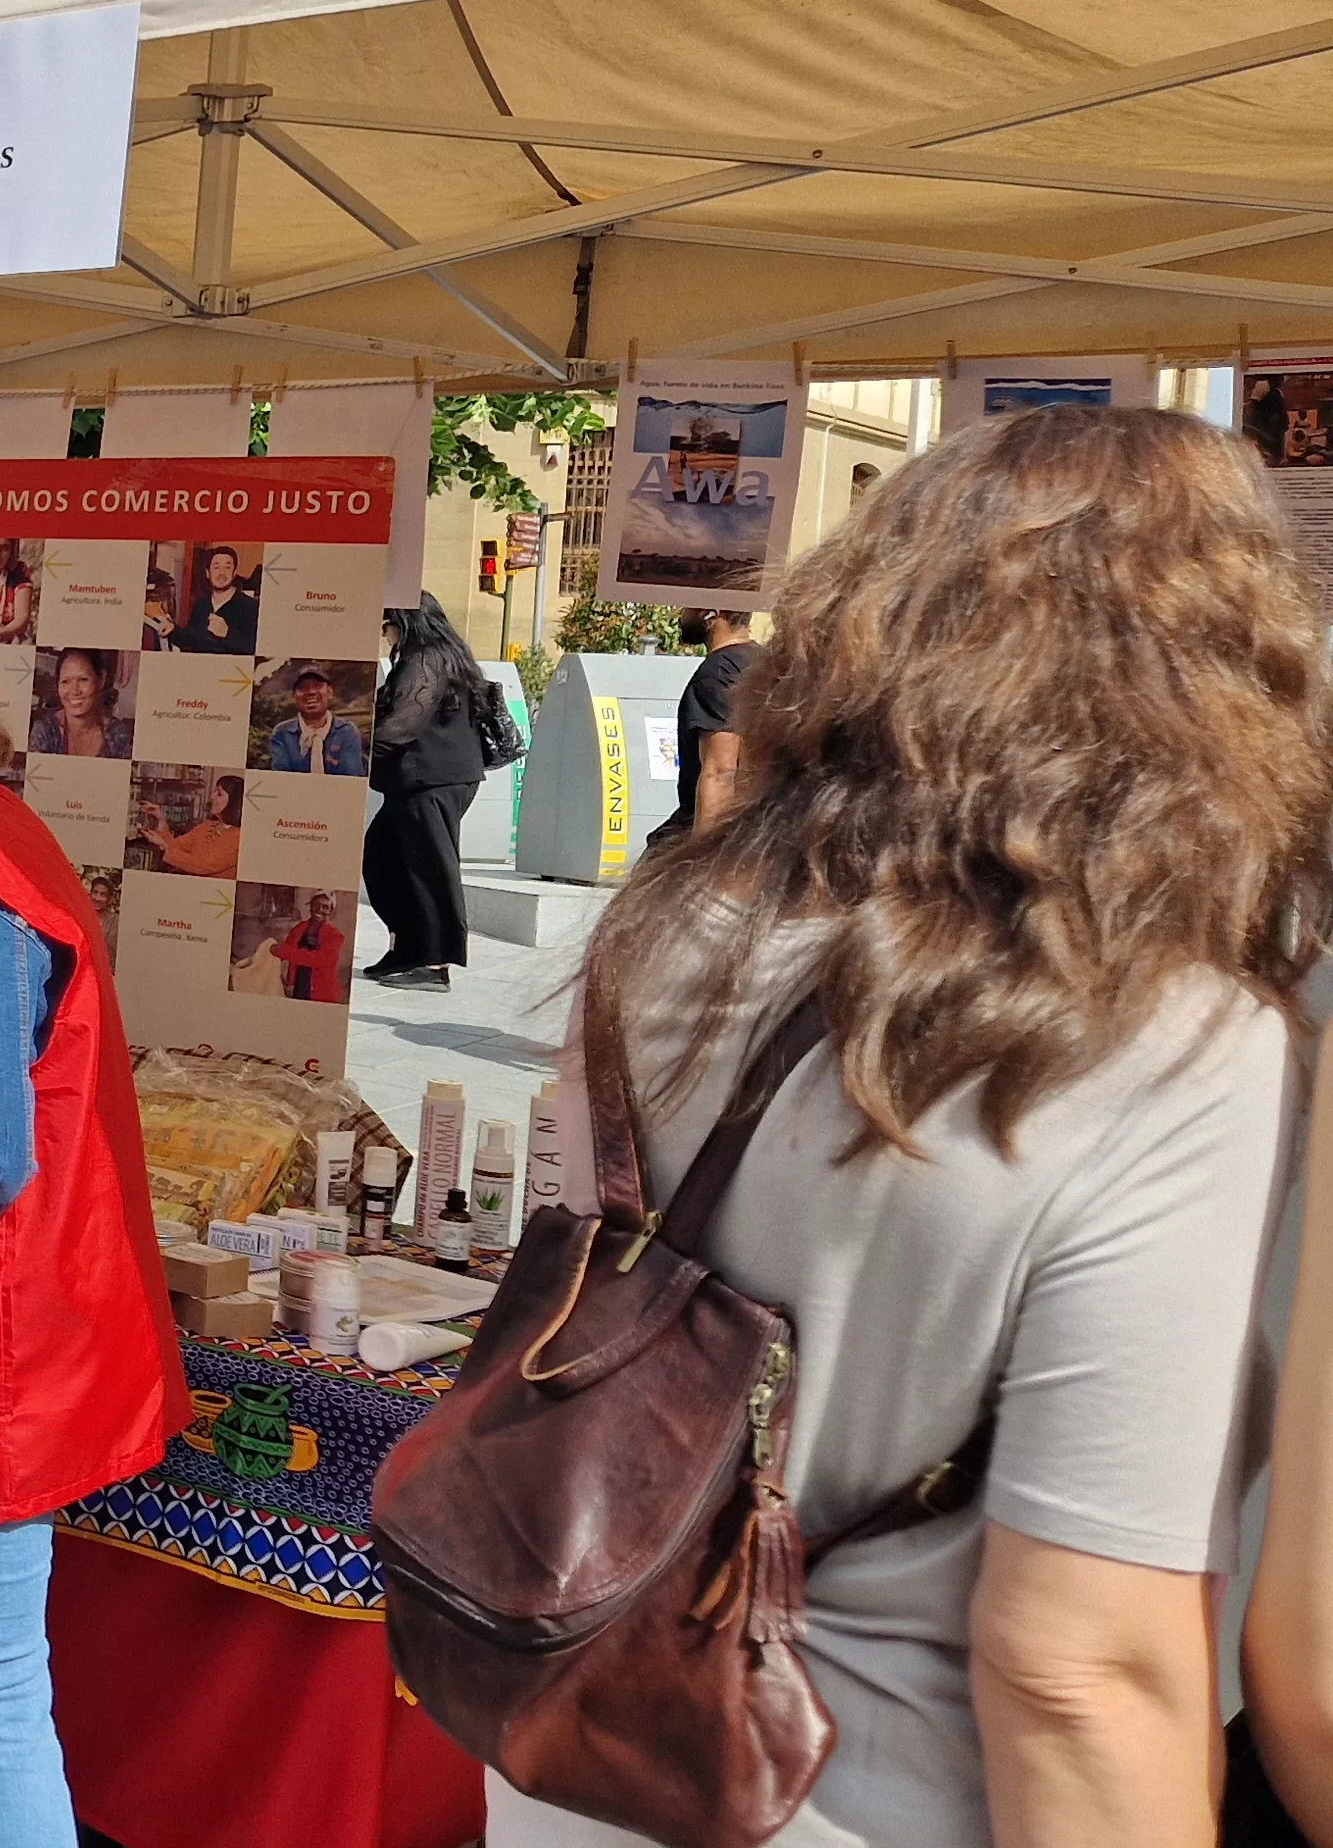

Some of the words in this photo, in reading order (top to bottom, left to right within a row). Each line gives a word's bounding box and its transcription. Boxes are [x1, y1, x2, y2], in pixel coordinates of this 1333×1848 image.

[663, 380, 688, 389] fuente
[689, 381, 700, 389] de
[701, 381, 718, 389] vida
[733, 381, 764, 390] Burkina
[630, 456, 770, 507] Awa
[82, 489, 249, 514] COMERCIO
[262, 489, 371, 515] JUSTO
[68, 584, 117, 594] Mamtuben
[306, 590, 337, 601] Bruno
[294, 603, 346, 613] Consumidor
[176, 698, 209, 711] Freddy
[193, 711, 232, 722] Colombia
[602, 706, 622, 832] ENVASES
[66, 800, 83, 809] Luis
[38, 810, 74, 821] Voluntario
[75, 813, 85, 822] de
[86, 813, 110, 824] tienda
[276, 818, 328, 831] Ascensión
[273, 831, 329, 843] Consumidora
[157, 918, 192, 931] Martha
[432, 1112, 457, 1174] NORMAL
[420, 1150, 430, 1171] VERA
[531, 1116, 563, 1197] GÁN
[419, 1172, 429, 1192] ALOE
[210, 1232, 232, 1249] ALOE
[233, 1235, 256, 1253] VERA
